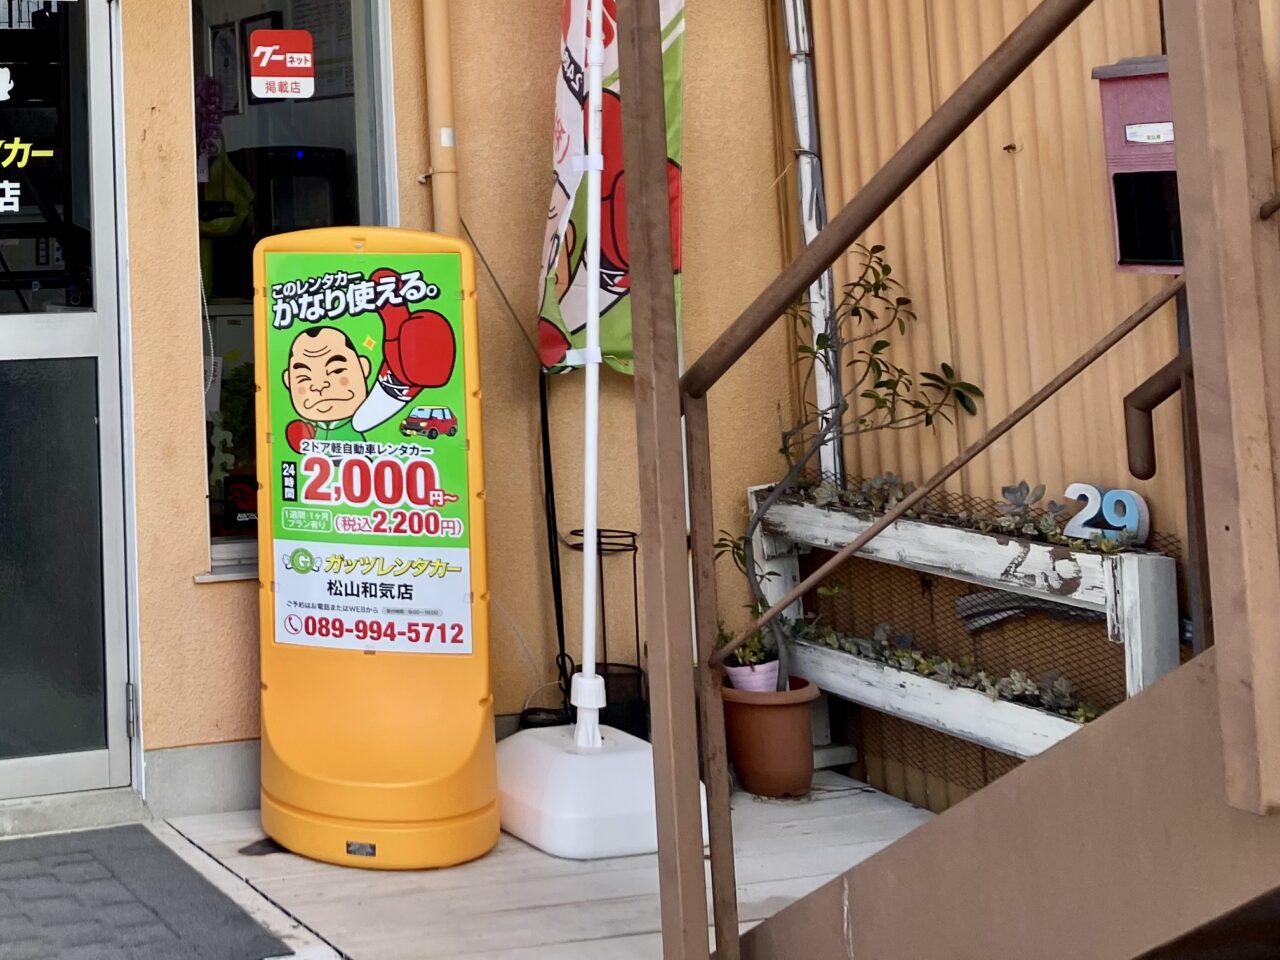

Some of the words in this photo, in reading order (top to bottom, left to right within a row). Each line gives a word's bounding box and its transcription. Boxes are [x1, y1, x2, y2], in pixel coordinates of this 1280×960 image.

[265, 80, 301, 94] 掲載店
[272, 271, 362, 298] このレンタカー
[273, 272, 439, 328] かなり使える。
[301, 441, 432, 457] 2ドア軽自動車レンタカー
[282, 463, 296, 500] 24時間
[1064, 483, 1148, 539] 29
[324, 554, 462, 578] ガッツレンタカー
[327, 579, 414, 601] 松山和気店
[304, 615, 464, 644] 089-994-5712
